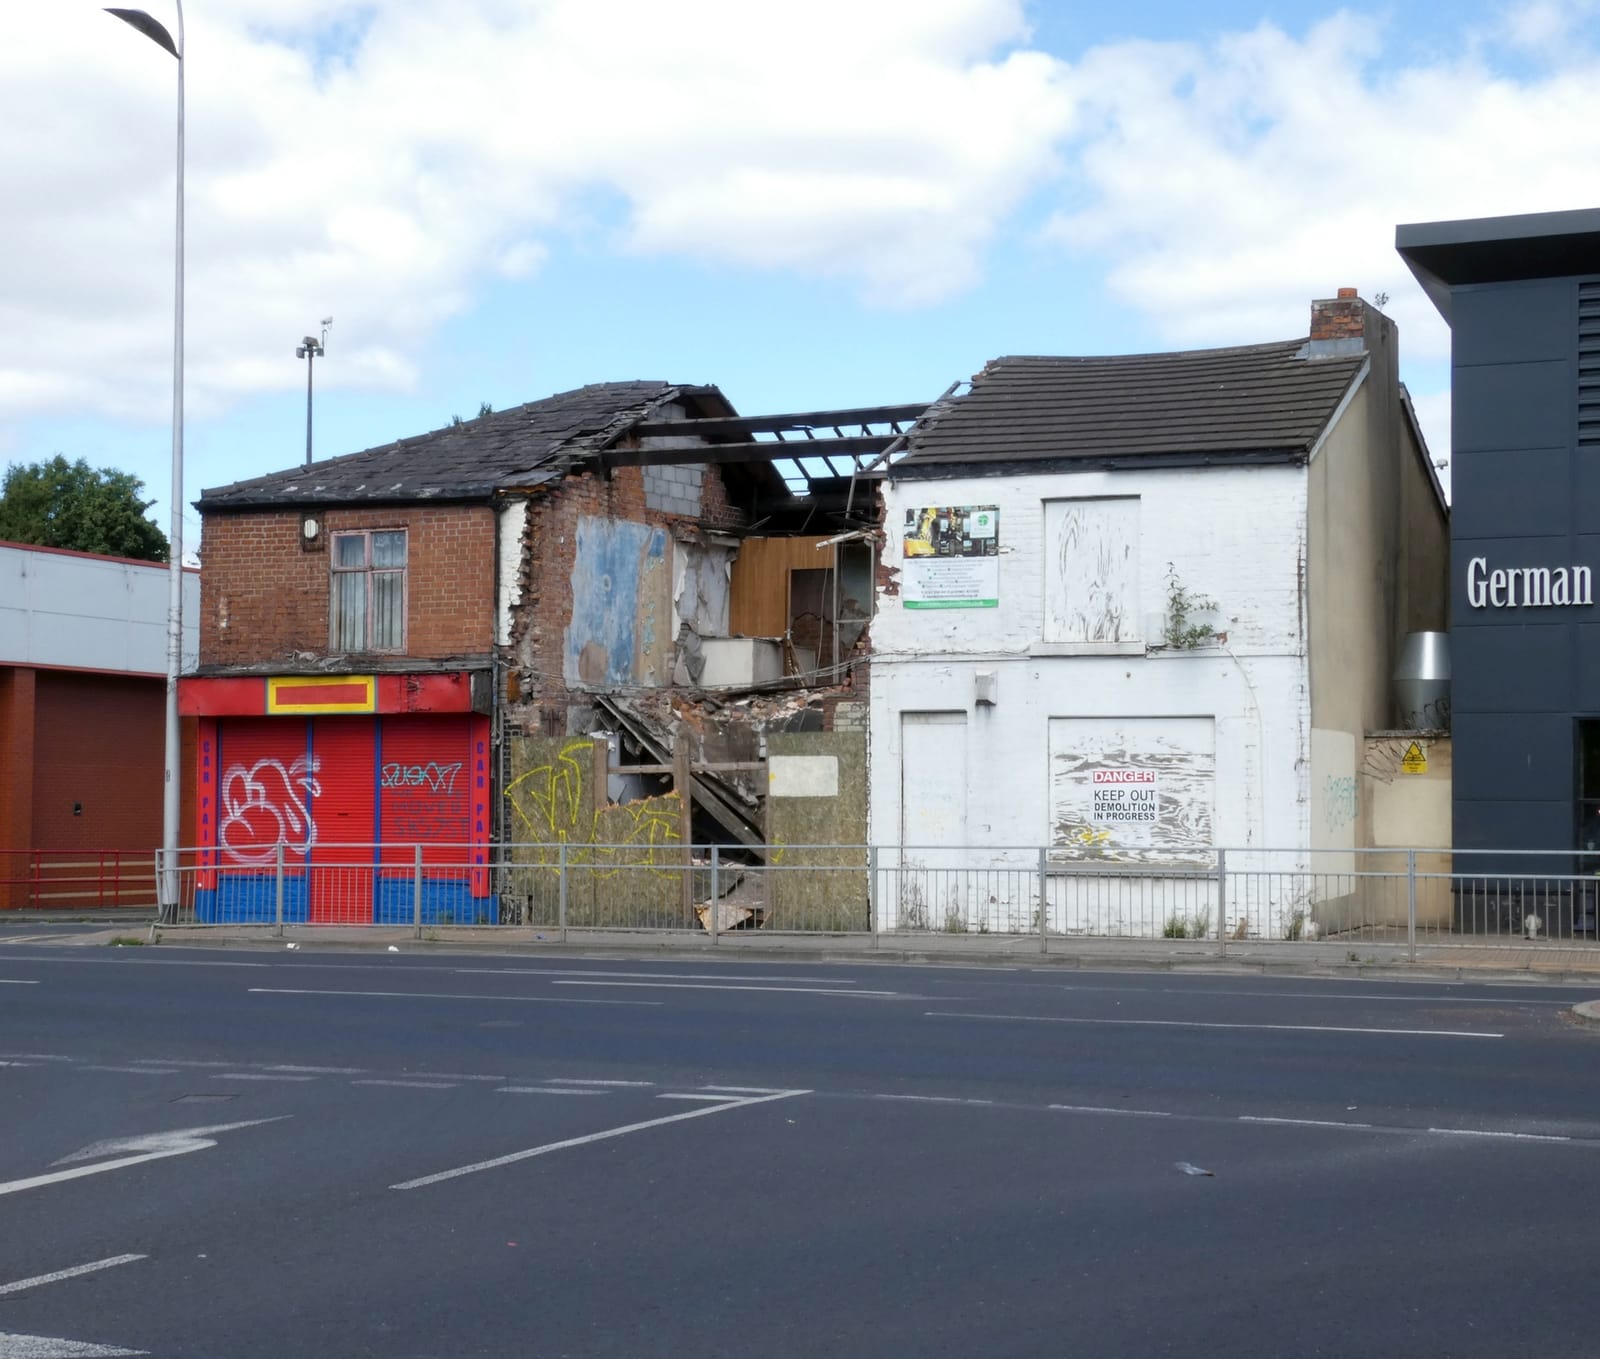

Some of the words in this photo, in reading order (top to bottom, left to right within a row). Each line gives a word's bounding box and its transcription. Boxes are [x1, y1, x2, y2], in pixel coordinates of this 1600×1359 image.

[1467, 557, 1593, 608] German
[476, 741, 484, 788] CAR
[1094, 771, 1154, 782] DANGER
[1094, 790, 1125, 801] KEEP
[1130, 790, 1155, 801] OUT
[1094, 802, 1156, 812] DEMOLITION
[1093, 812, 1103, 820] IN
[1106, 812, 1156, 821] PROGRESS
